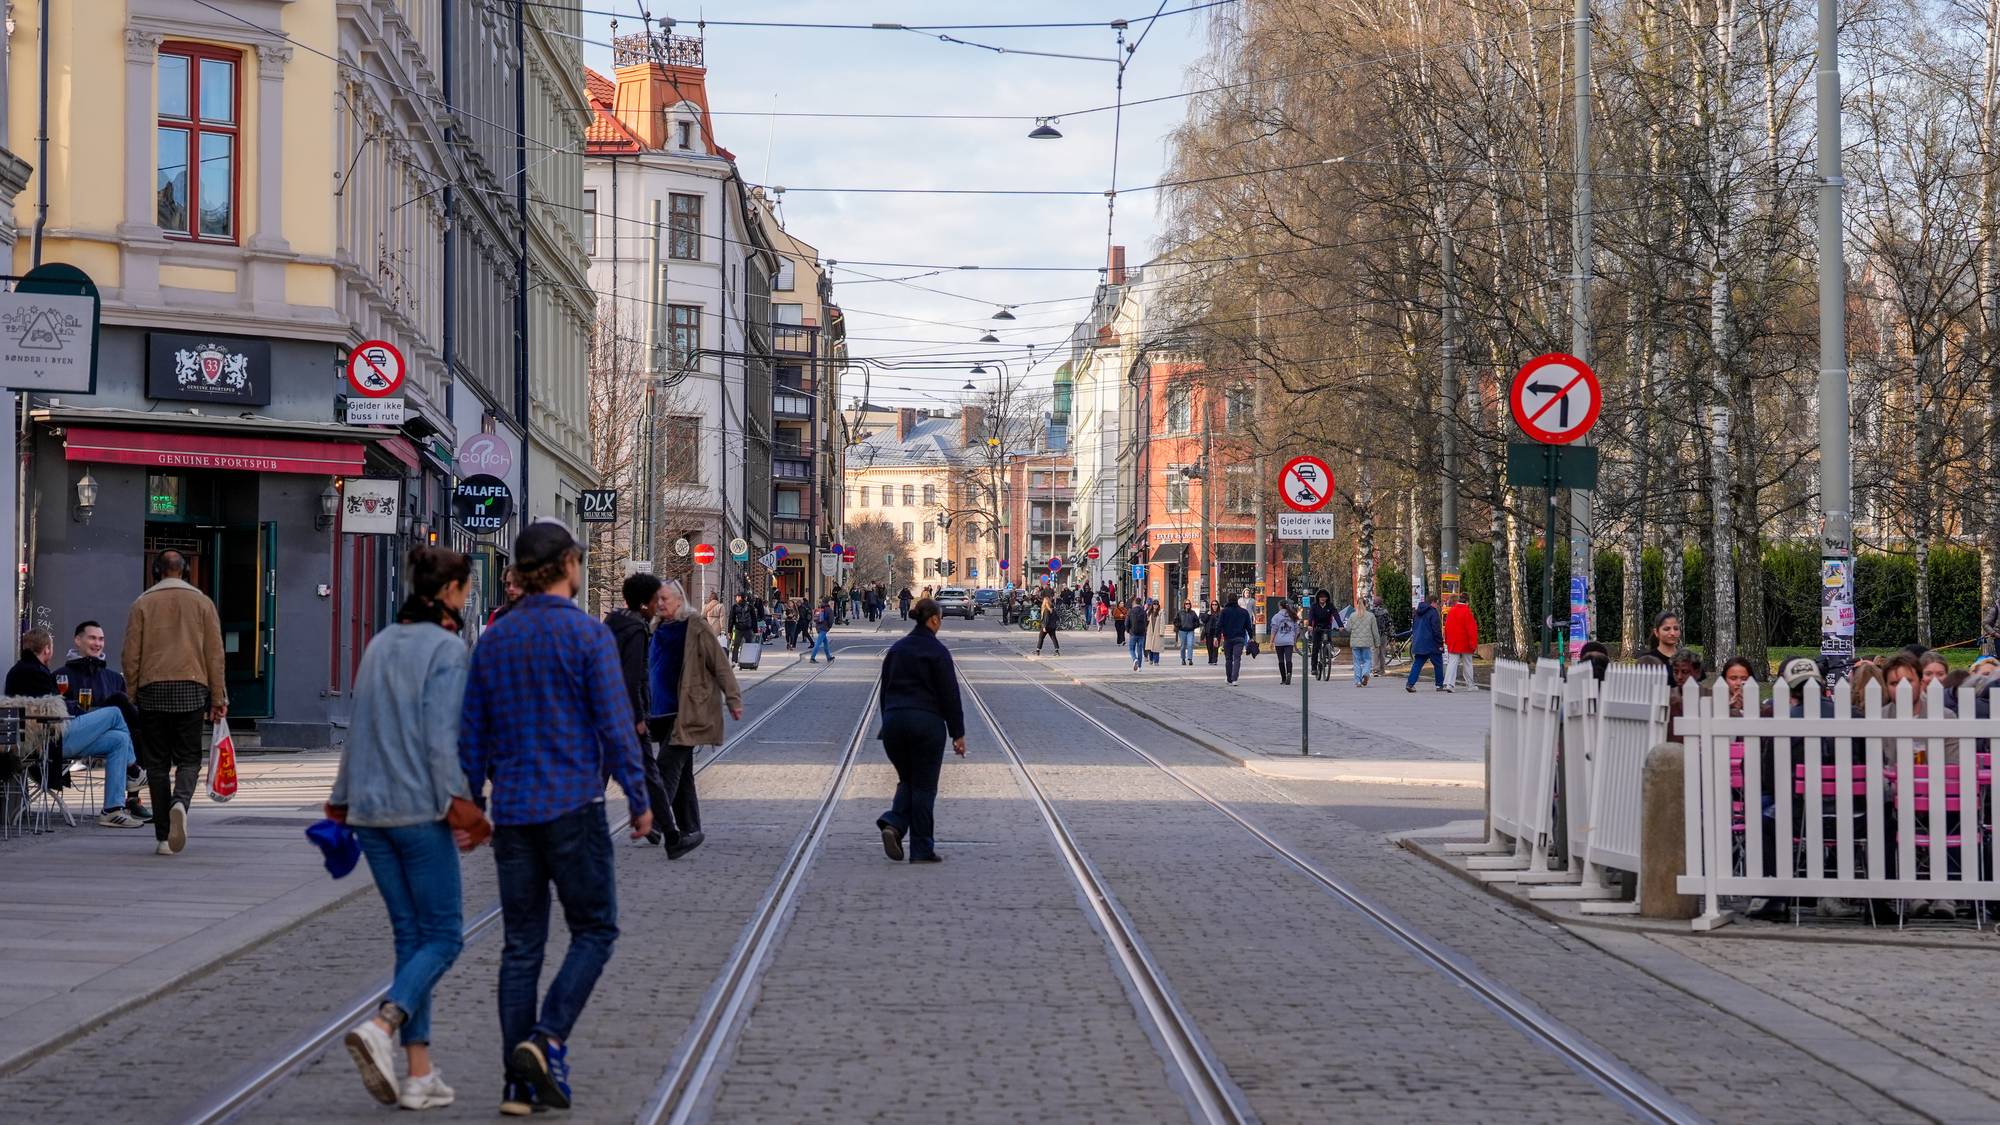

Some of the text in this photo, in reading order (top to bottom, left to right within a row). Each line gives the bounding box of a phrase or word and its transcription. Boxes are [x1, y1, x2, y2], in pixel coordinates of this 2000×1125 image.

[5, 354, 41, 363] BØNDER
[51, 357, 73, 365] BYEN
[206, 360, 219, 372] 33
[350, 402, 402, 411] Gjelder ikke
[351, 412, 372, 420] buss
[158, 454, 278, 470] GENUINE SPORTSPUB
[460, 452, 510, 465] COUCH
[458, 485, 509, 497] FALAFEL
[584, 492, 616, 511] DLX
[475, 503, 486, 515] n
[464, 516, 501, 528] JUICE
[1280, 517, 1332, 526] Gjelder ikke
[1282, 527, 1303, 535] buss
